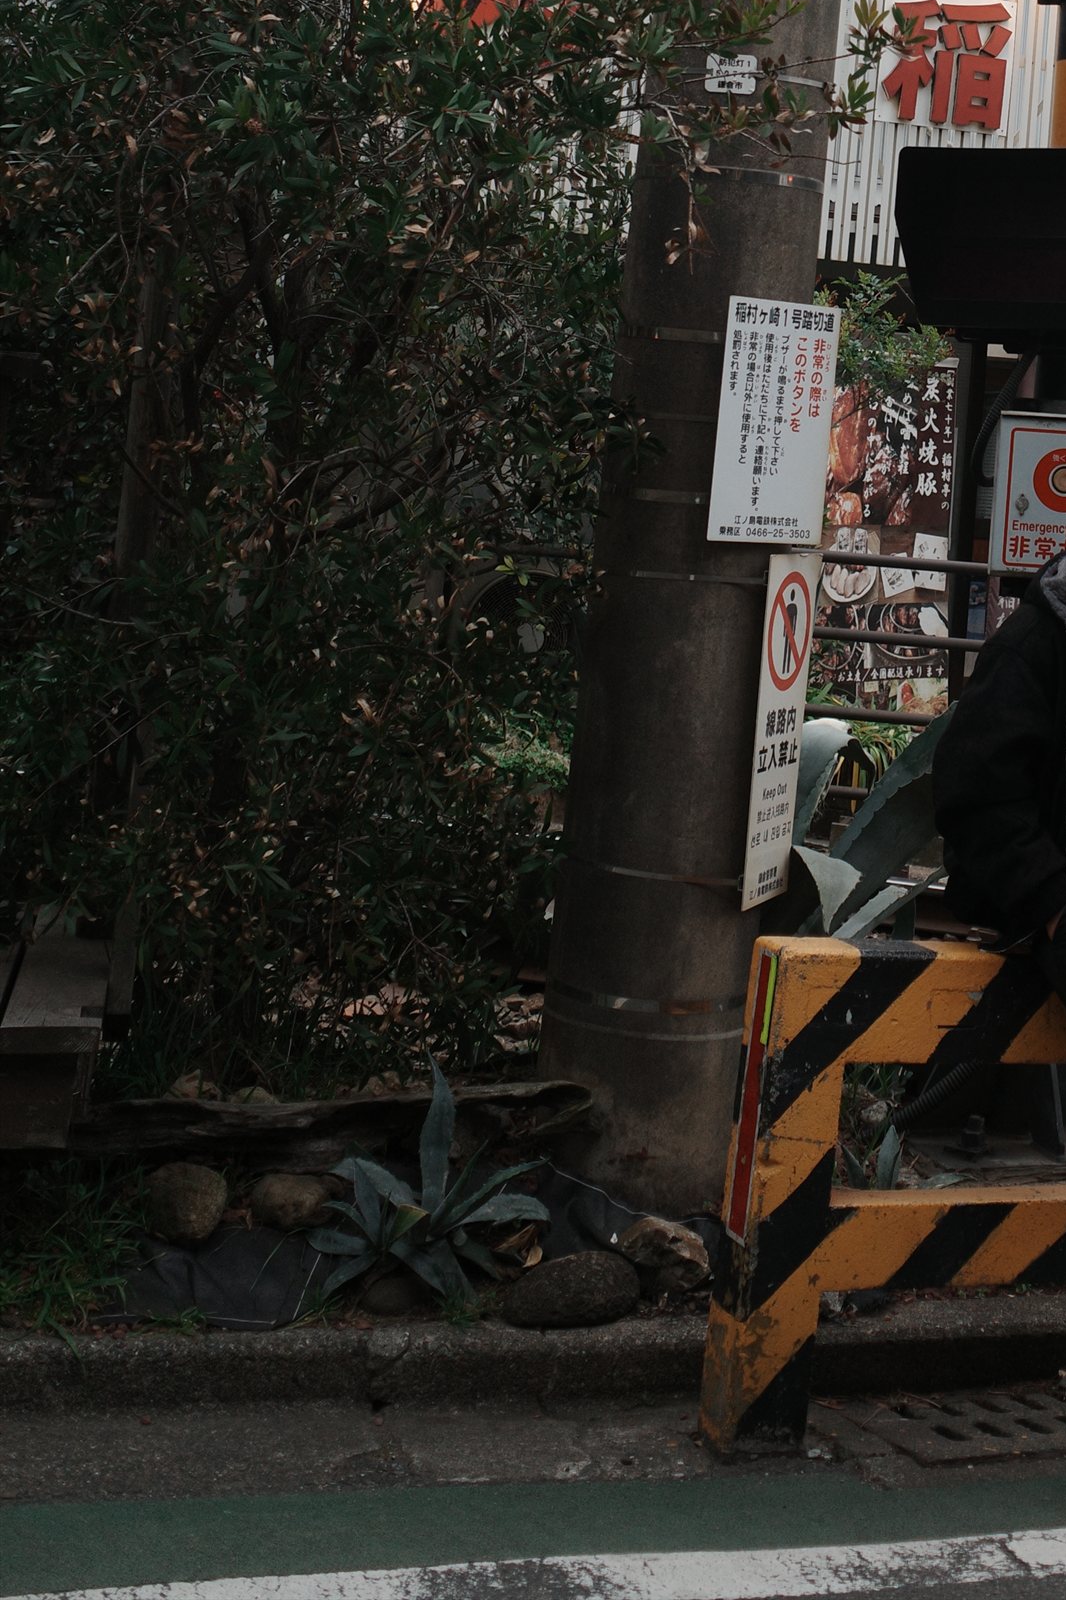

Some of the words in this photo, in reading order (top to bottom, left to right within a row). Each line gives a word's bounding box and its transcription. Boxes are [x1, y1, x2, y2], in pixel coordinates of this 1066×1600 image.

[729, 330, 742, 396] 処罰されます。
[789, 337, 808, 433] このボタンを
[808, 338, 827, 418] 非常の際は
[738, 331, 759, 465] 非常の場合以外に使用すると
[751, 333, 775, 512] 使用後はただちに下記へ連絡願います。
[769, 335, 791, 476] ブザーが鳴るまで押して下さい
[734, 515, 799, 527] 江ノ島電鉄株式会社
[746, 527, 811, 539] 0466-25-3503
[765, 705, 797, 738] 線路内
[757, 738, 798, 774] 立入禁止
[762, 787, 776, 801] Keep
[777, 783, 788, 796] Out
